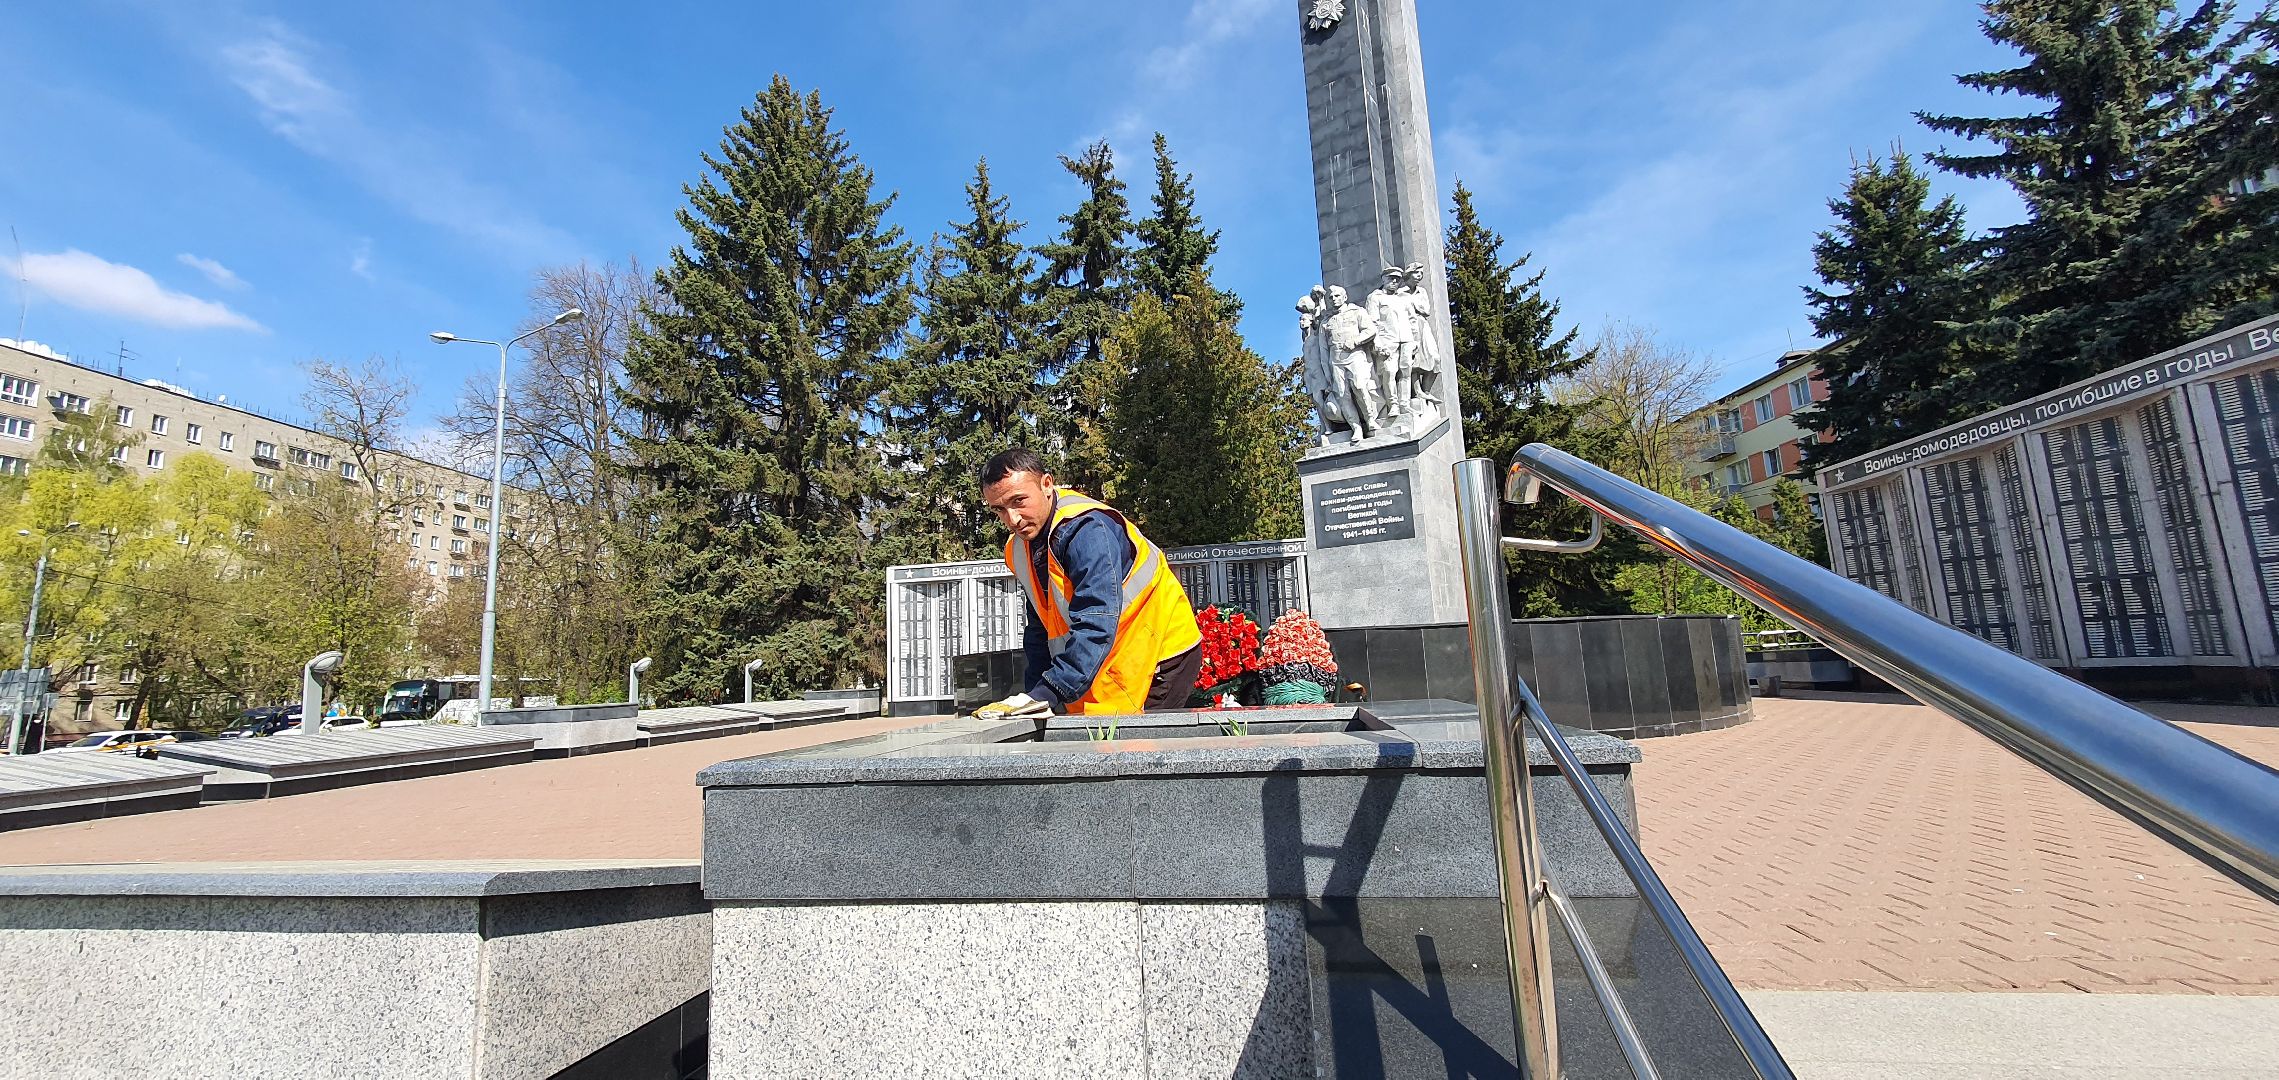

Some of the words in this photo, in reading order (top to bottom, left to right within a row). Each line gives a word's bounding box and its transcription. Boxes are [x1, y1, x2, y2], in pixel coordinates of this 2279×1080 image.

[1864, 413, 2031, 474] Воины-домодедовцы,
[2035, 374, 2142, 420] погибшие
[2145, 368, 2161, 384] в
[2164, 344, 2234, 378] годы
[1332, 485, 1362, 495] Обелиск
[1363, 482, 1388, 491] Славы
[1374, 499, 1393, 507] годы
[1347, 509, 1378, 519] Великой
[1324, 518, 1377, 532] Отечественной
[1378, 515, 1405, 525] Войны
[932, 565, 1010, 576] Воины-домод
[1164, 549, 1209, 561] еликой
[1211, 542, 1302, 558] Отечественной
